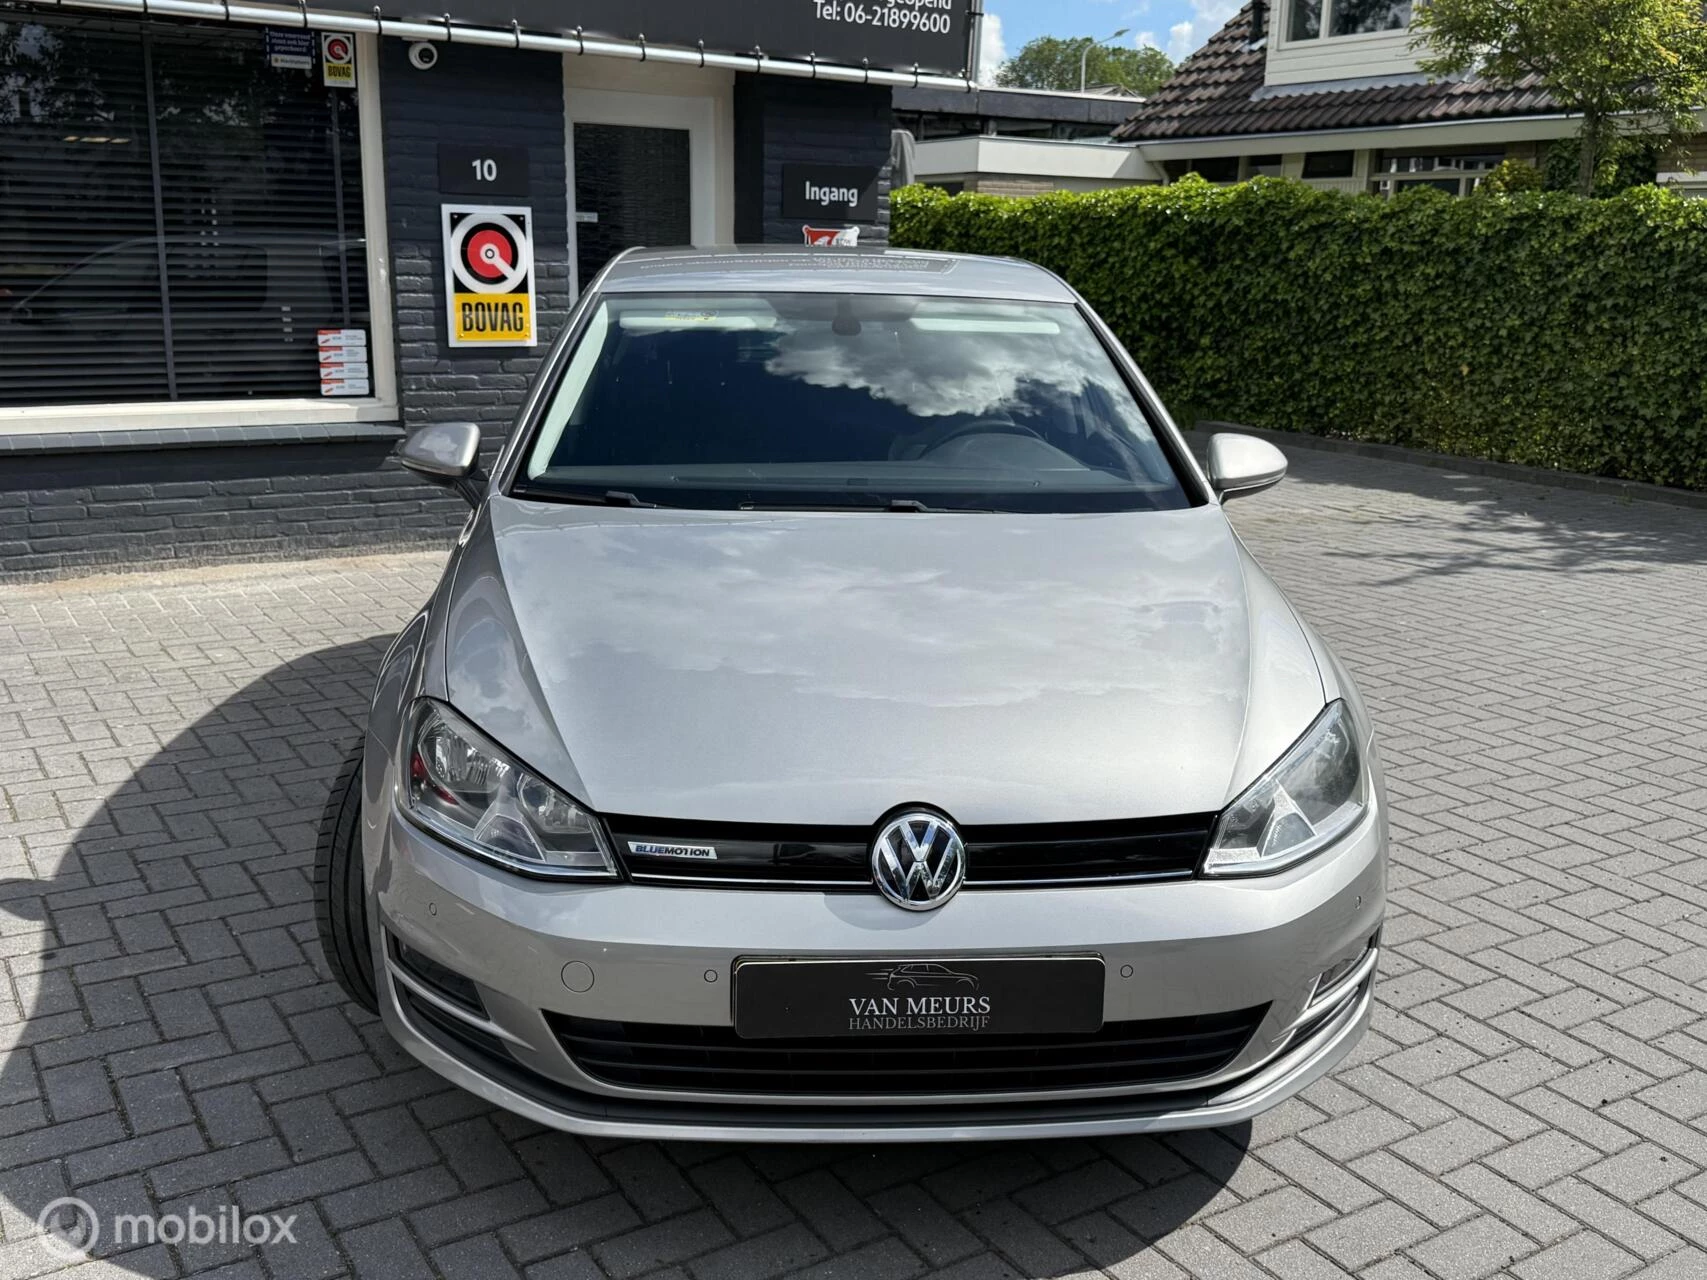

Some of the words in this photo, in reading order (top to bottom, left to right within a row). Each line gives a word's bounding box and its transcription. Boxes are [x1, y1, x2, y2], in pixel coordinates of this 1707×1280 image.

[886, 0, 952, 11] gpend
[813, 0, 841, 21] Tel:
[844, 2, 951, 34] 06-21899600
[328, 66, 352, 77] BOVAG
[472, 159, 497, 182] 10
[804, 181, 858, 208] Ingang
[462, 301, 525, 333] BOVAG
[635, 845, 711, 857] BLUEMOTION
[849, 997, 899, 1016] VAN
[905, 996, 991, 1015] MEURS
[848, 1015, 991, 1032] HANDELSBEDRIJF
